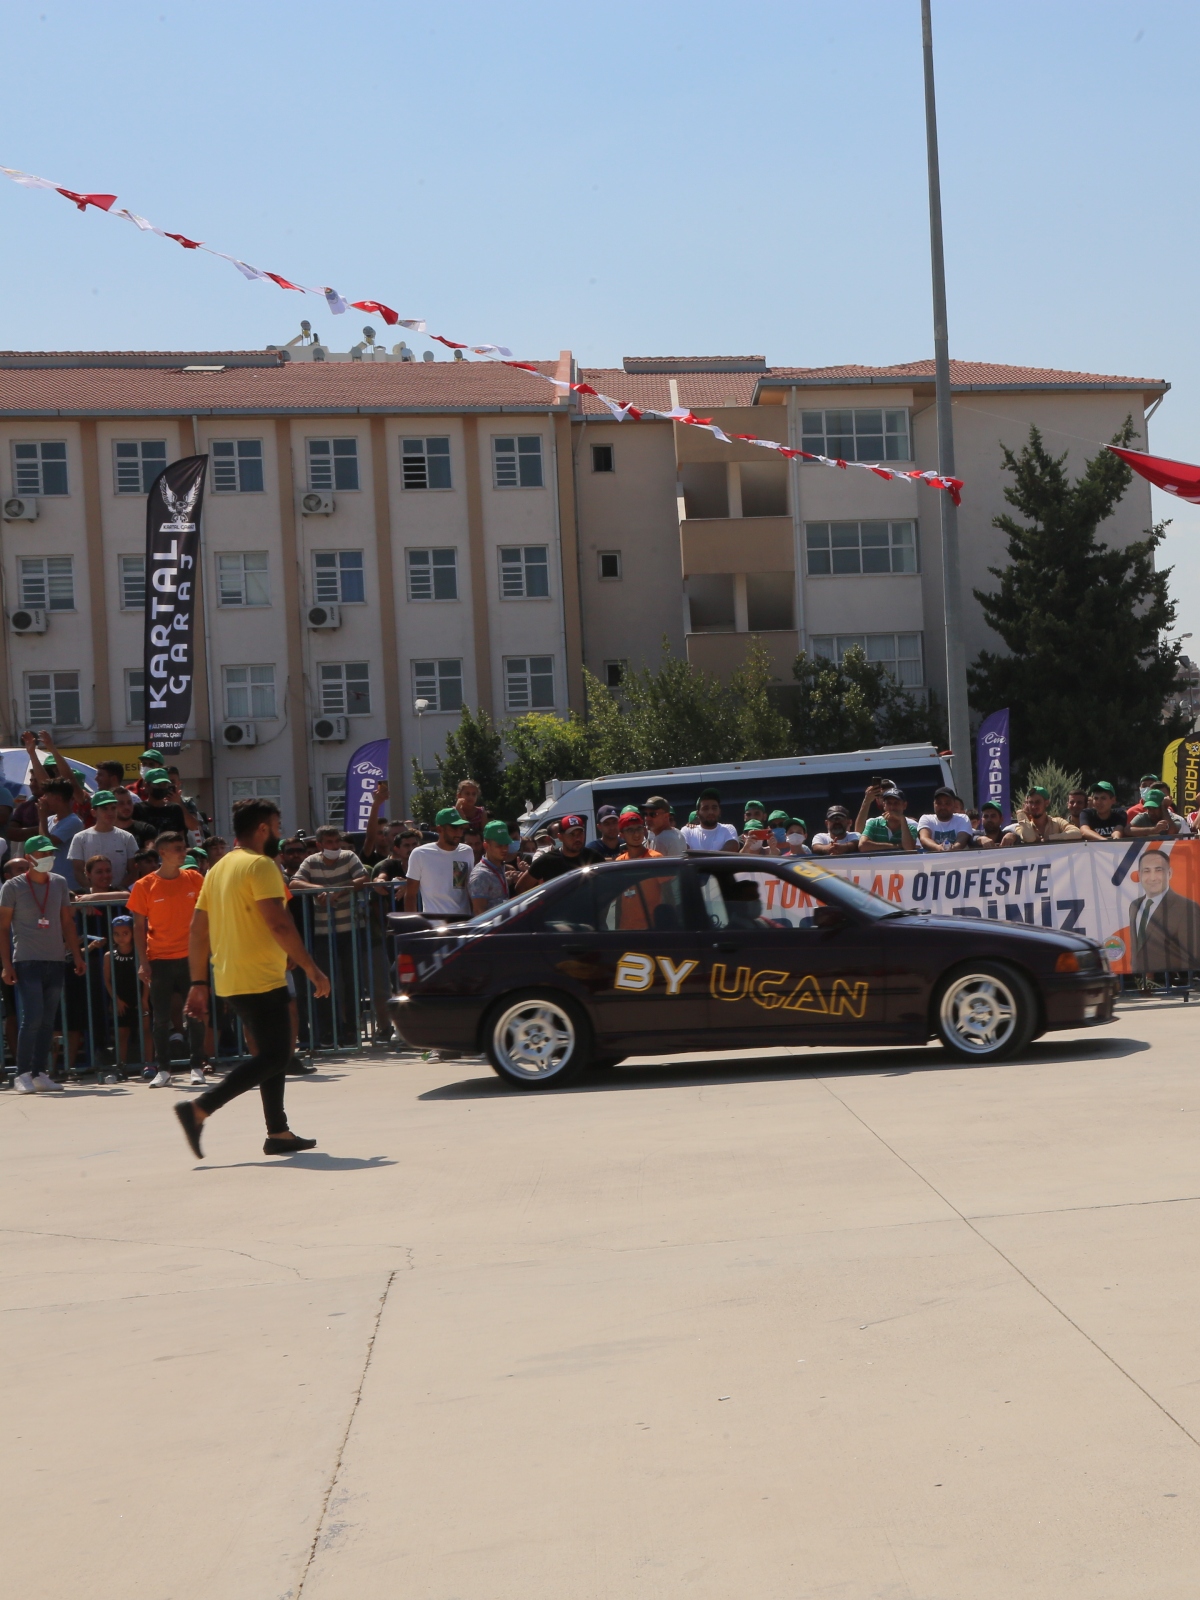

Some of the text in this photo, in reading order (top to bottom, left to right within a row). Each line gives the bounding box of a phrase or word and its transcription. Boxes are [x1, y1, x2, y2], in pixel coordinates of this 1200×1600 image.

[150, 540, 178, 709] KARTAL
[169, 553, 193, 695] GARAJ
[1184, 757, 1200, 802] HARD
[911, 863, 1052, 902] OTOFEST'E
[614, 951, 700, 995] BY
